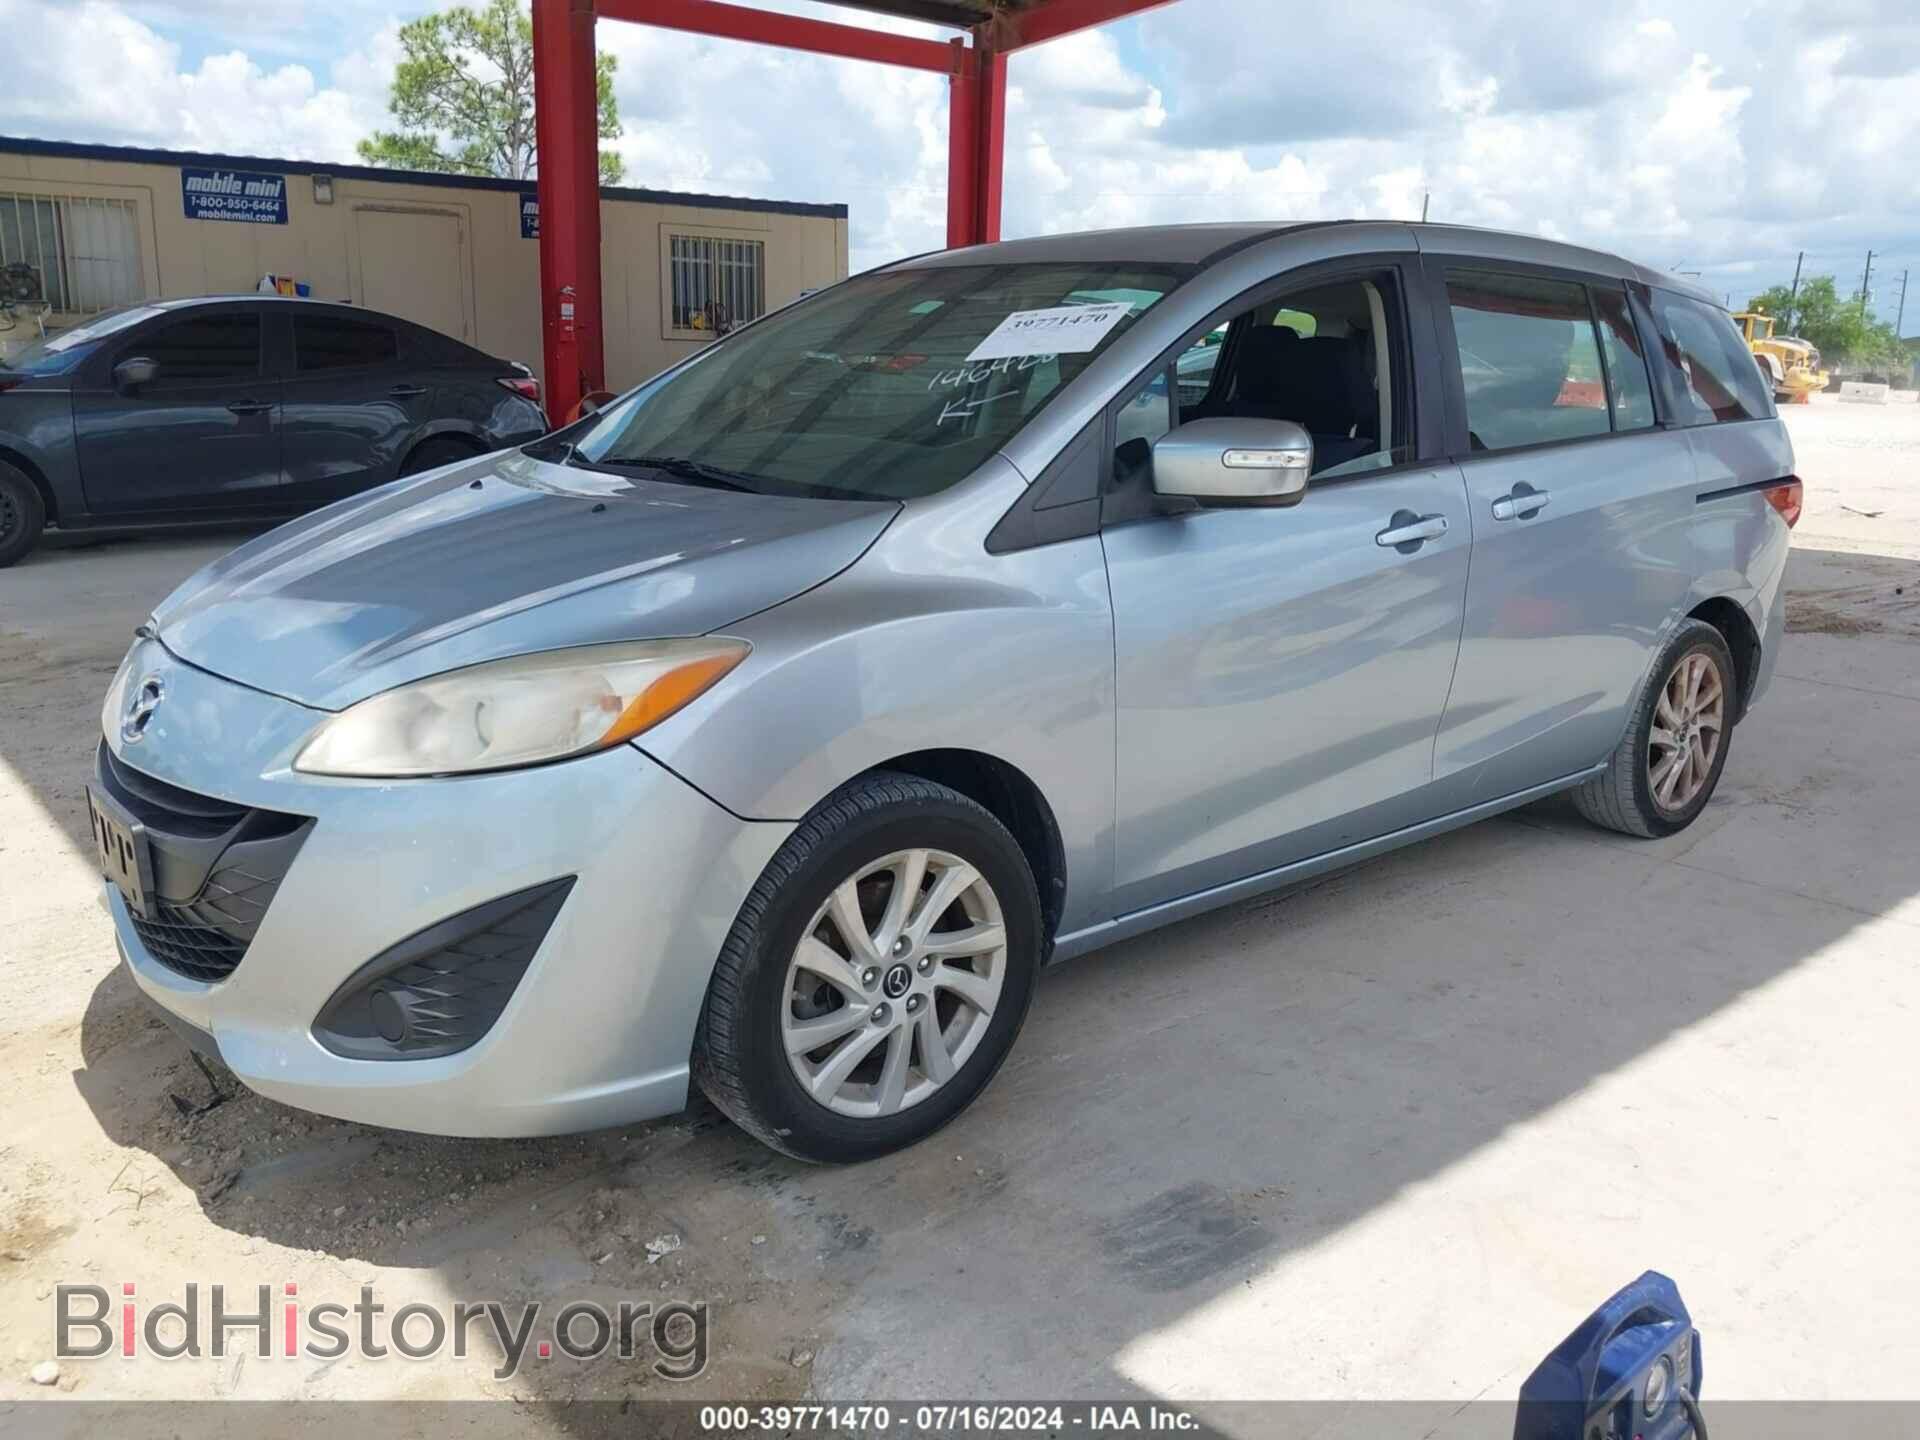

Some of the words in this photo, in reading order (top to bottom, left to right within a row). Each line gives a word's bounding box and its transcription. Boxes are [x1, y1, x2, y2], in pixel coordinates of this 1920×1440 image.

[186, 172, 242, 194] mobile
[245, 179, 282, 197] mini
[191, 196, 280, 211] 1-800-950-6464
[198, 209, 277, 222] mobilemini.com
